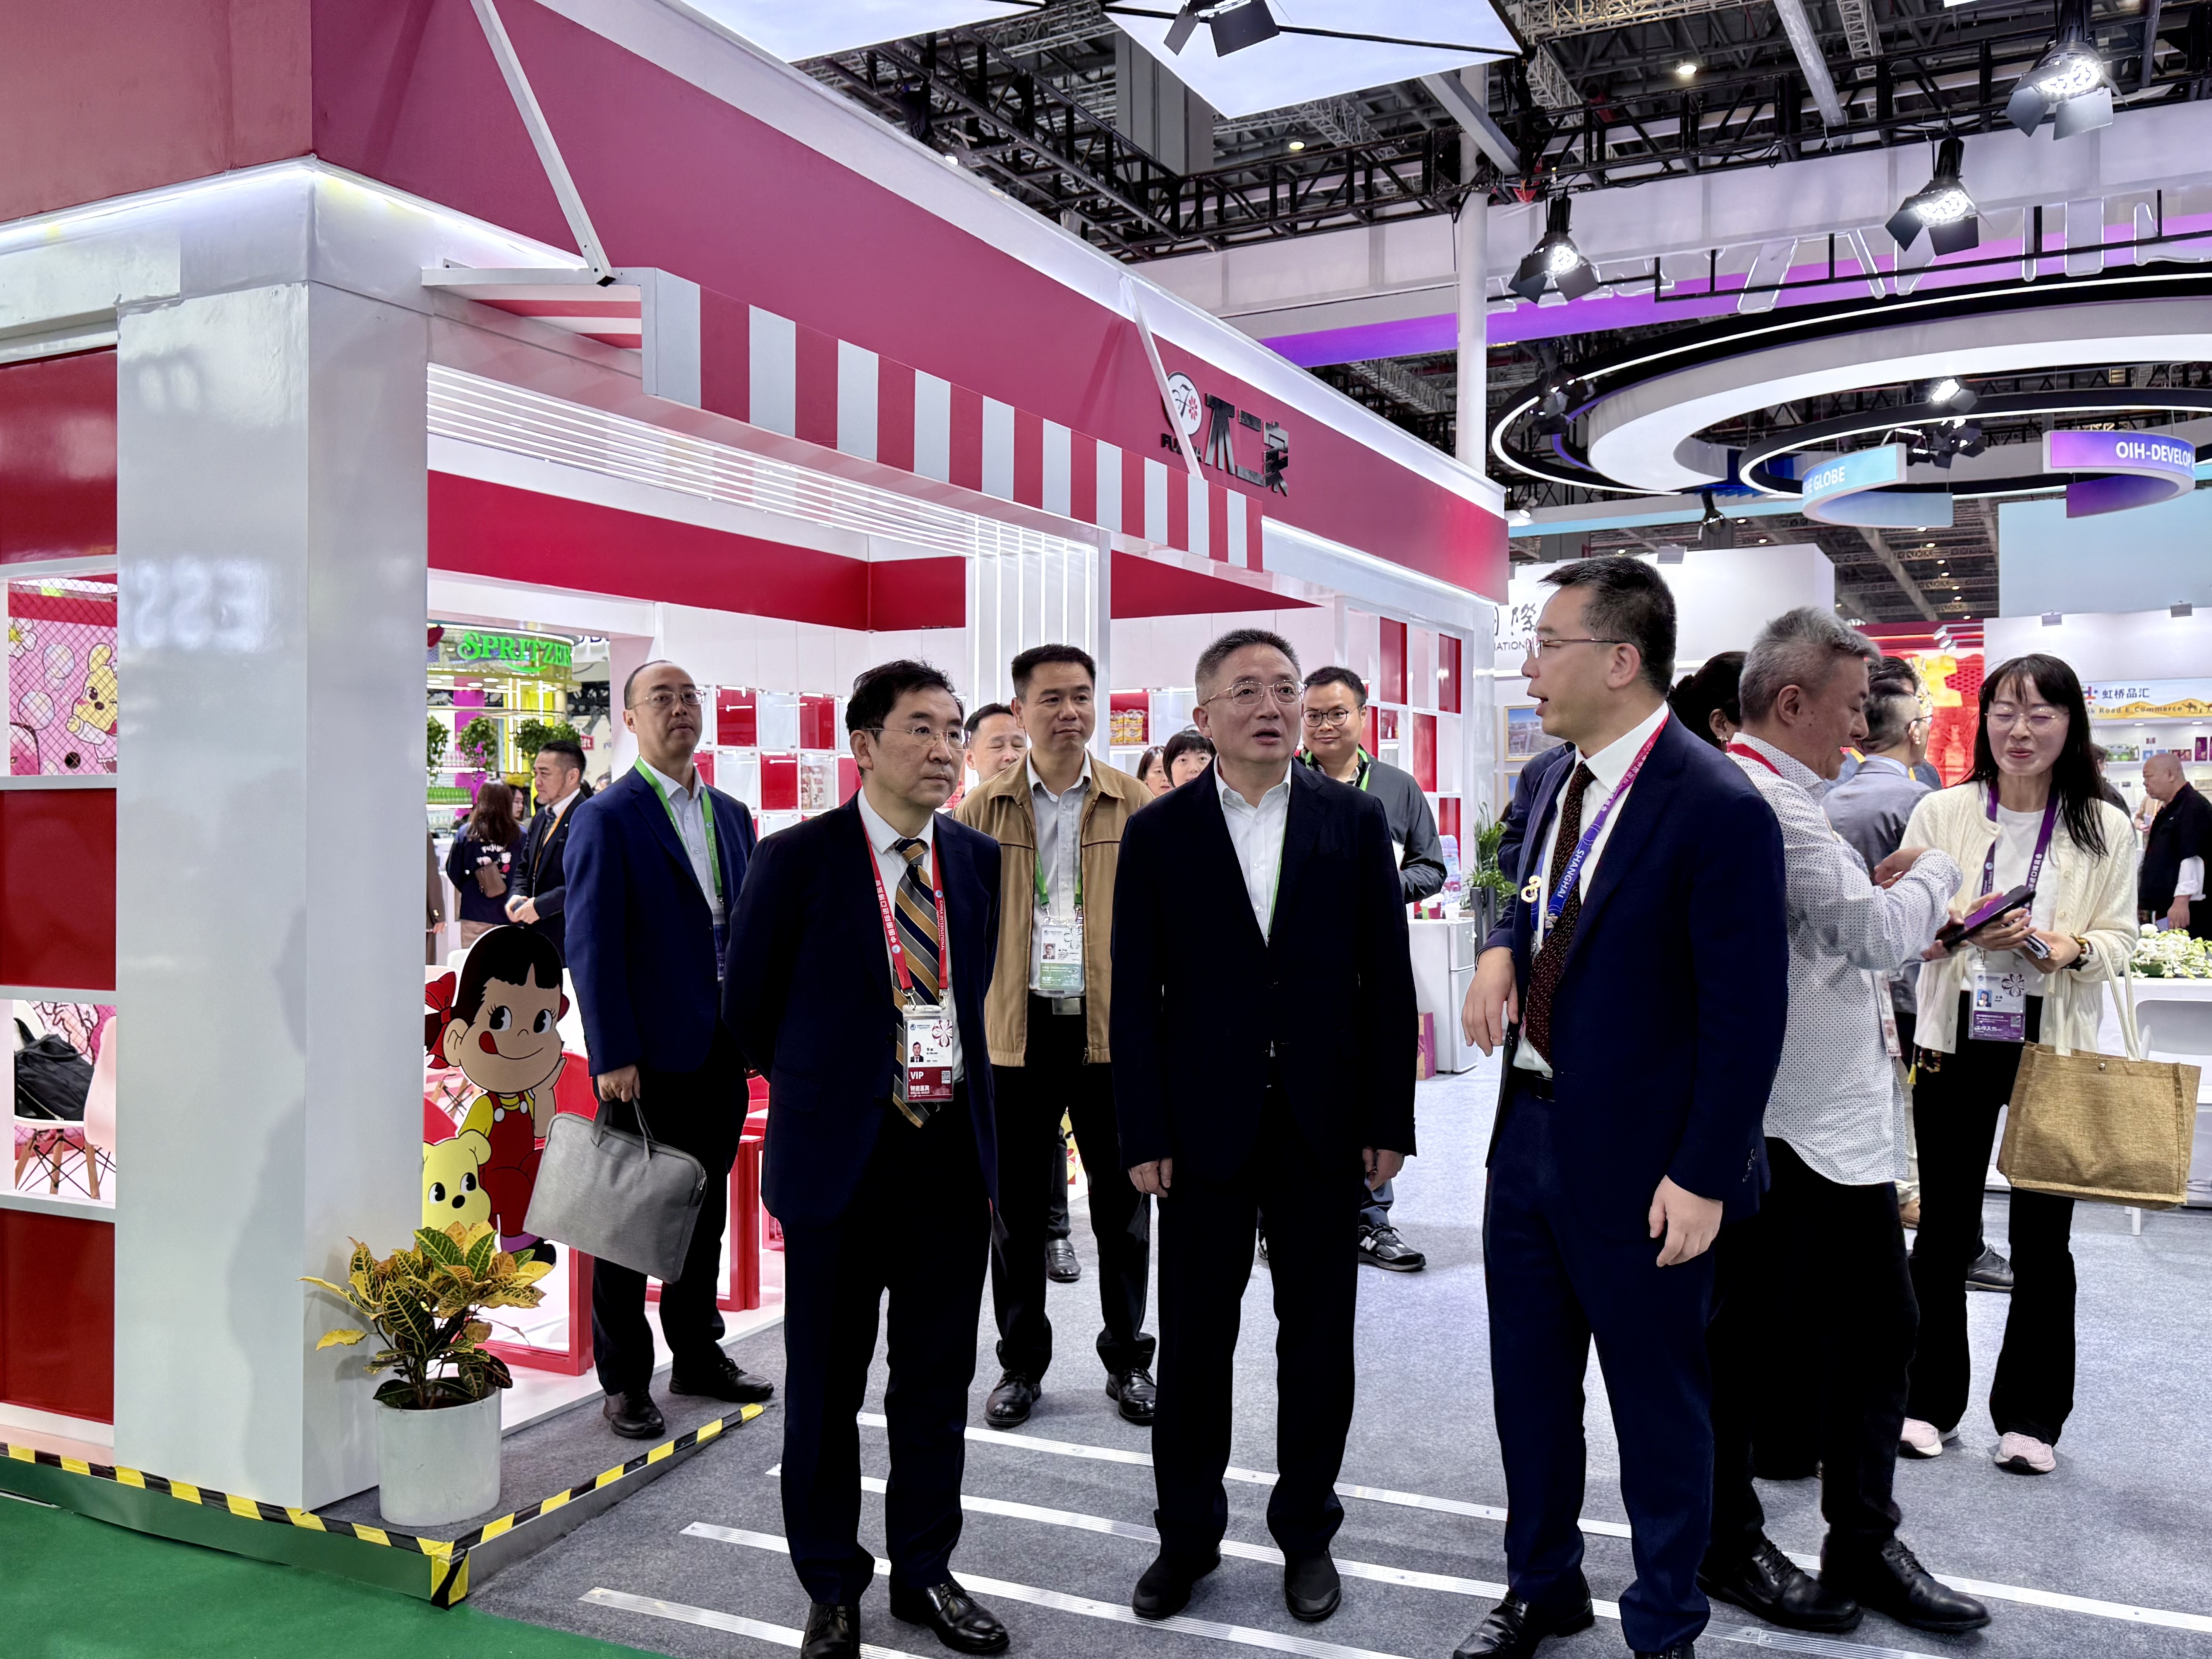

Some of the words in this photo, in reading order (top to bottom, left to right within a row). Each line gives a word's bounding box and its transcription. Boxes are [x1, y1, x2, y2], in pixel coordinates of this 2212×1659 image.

[1204, 393, 1289, 496] 不二家
[1814, 466, 1845, 491] GLOBE
[457, 631, 572, 668] SPRITZER
[1494, 641, 1525, 651] ATION
[2102, 688, 2150, 699] 虹桥品汇
[1557, 848, 1584, 898] SHANGHAI
[910, 1071, 924, 1080] VIP
